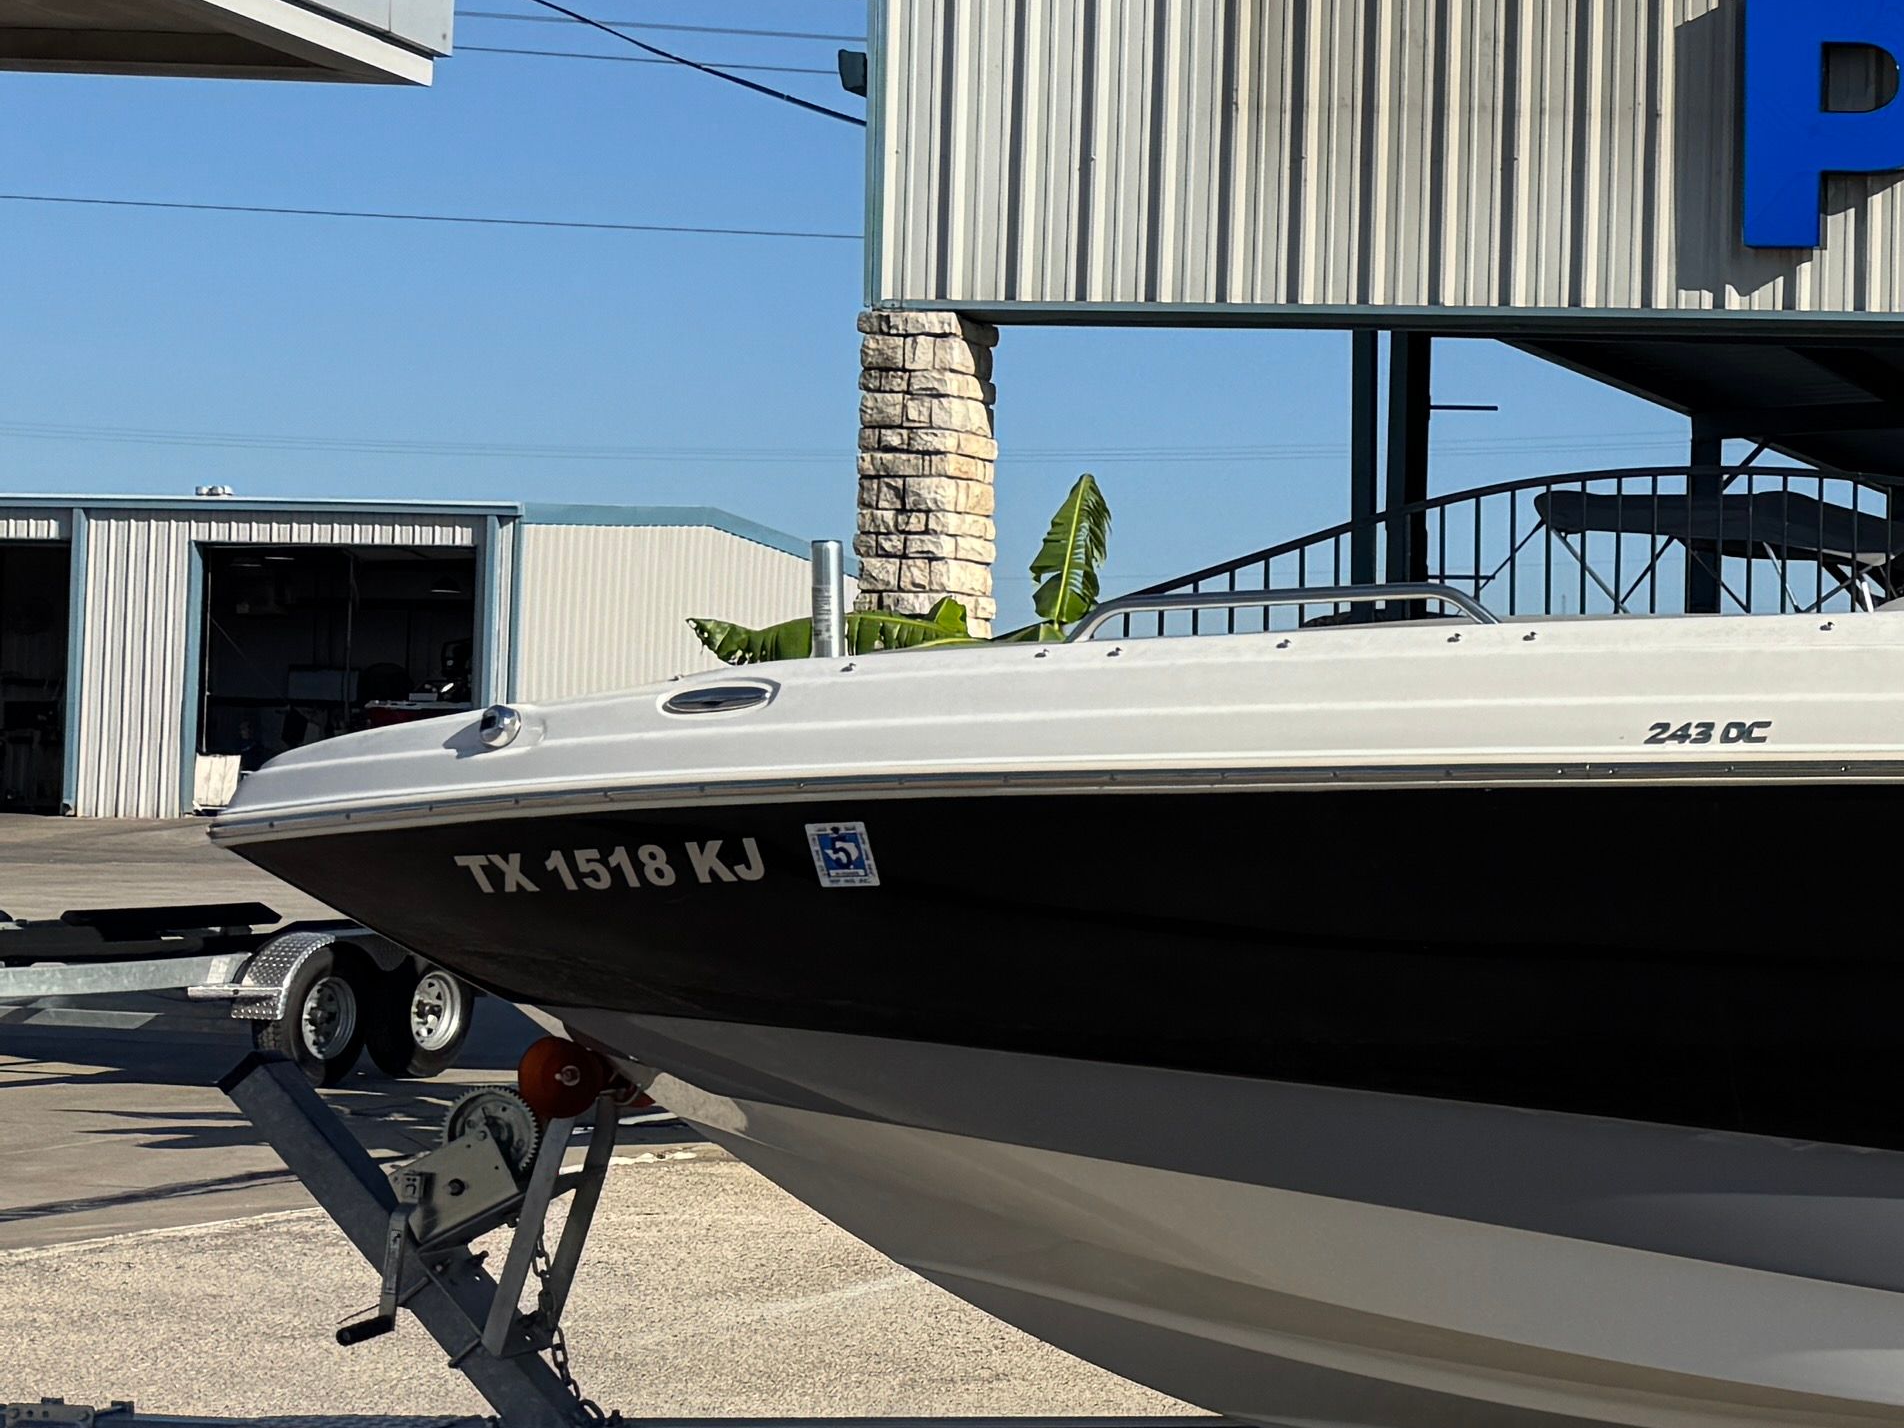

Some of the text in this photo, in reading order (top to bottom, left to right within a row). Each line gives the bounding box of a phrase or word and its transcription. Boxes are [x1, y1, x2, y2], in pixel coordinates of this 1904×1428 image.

[1642, 721, 1716, 745] 243
[453, 852, 541, 894] TX
[545, 843, 677, 891] 1518
[684, 836, 766, 884] KJ
